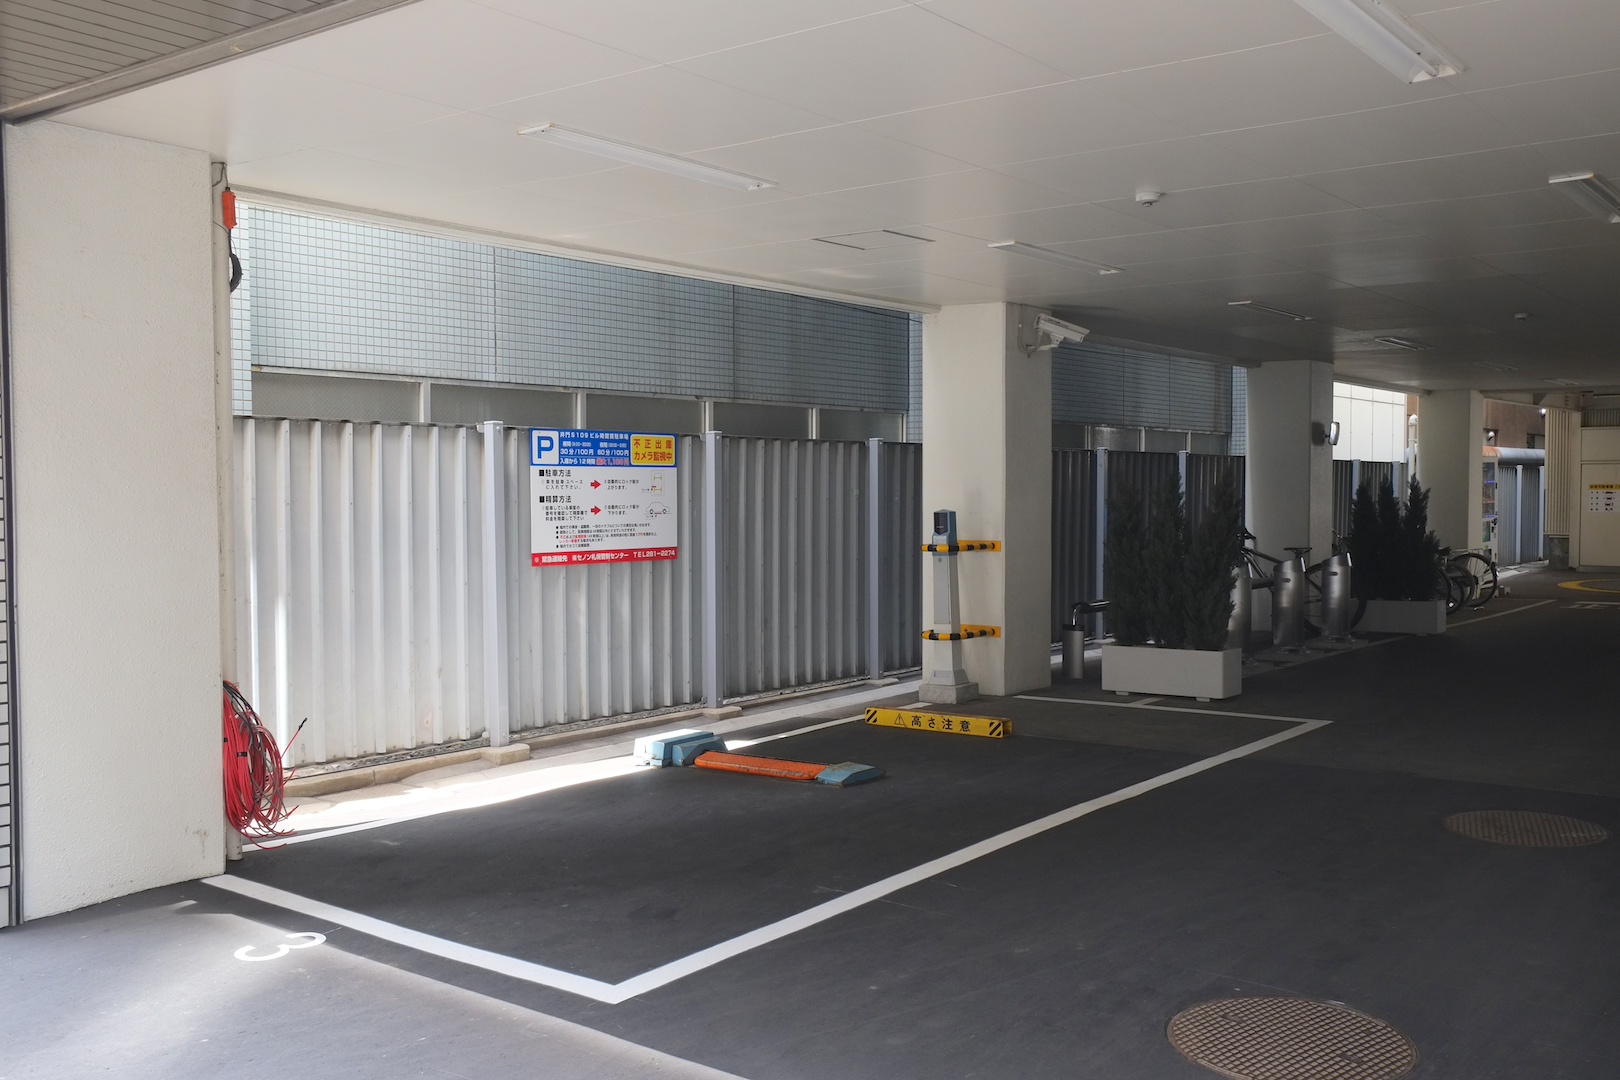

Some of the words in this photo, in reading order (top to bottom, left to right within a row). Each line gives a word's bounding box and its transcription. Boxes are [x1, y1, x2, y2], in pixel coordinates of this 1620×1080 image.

[538, 436, 553, 459] P
[634, 439, 672, 449] 不正出庫
[634, 451, 672, 461] カメラ監視中
[911, 714, 971, 732] 高さ注意
[234, 932, 327, 961] 3
